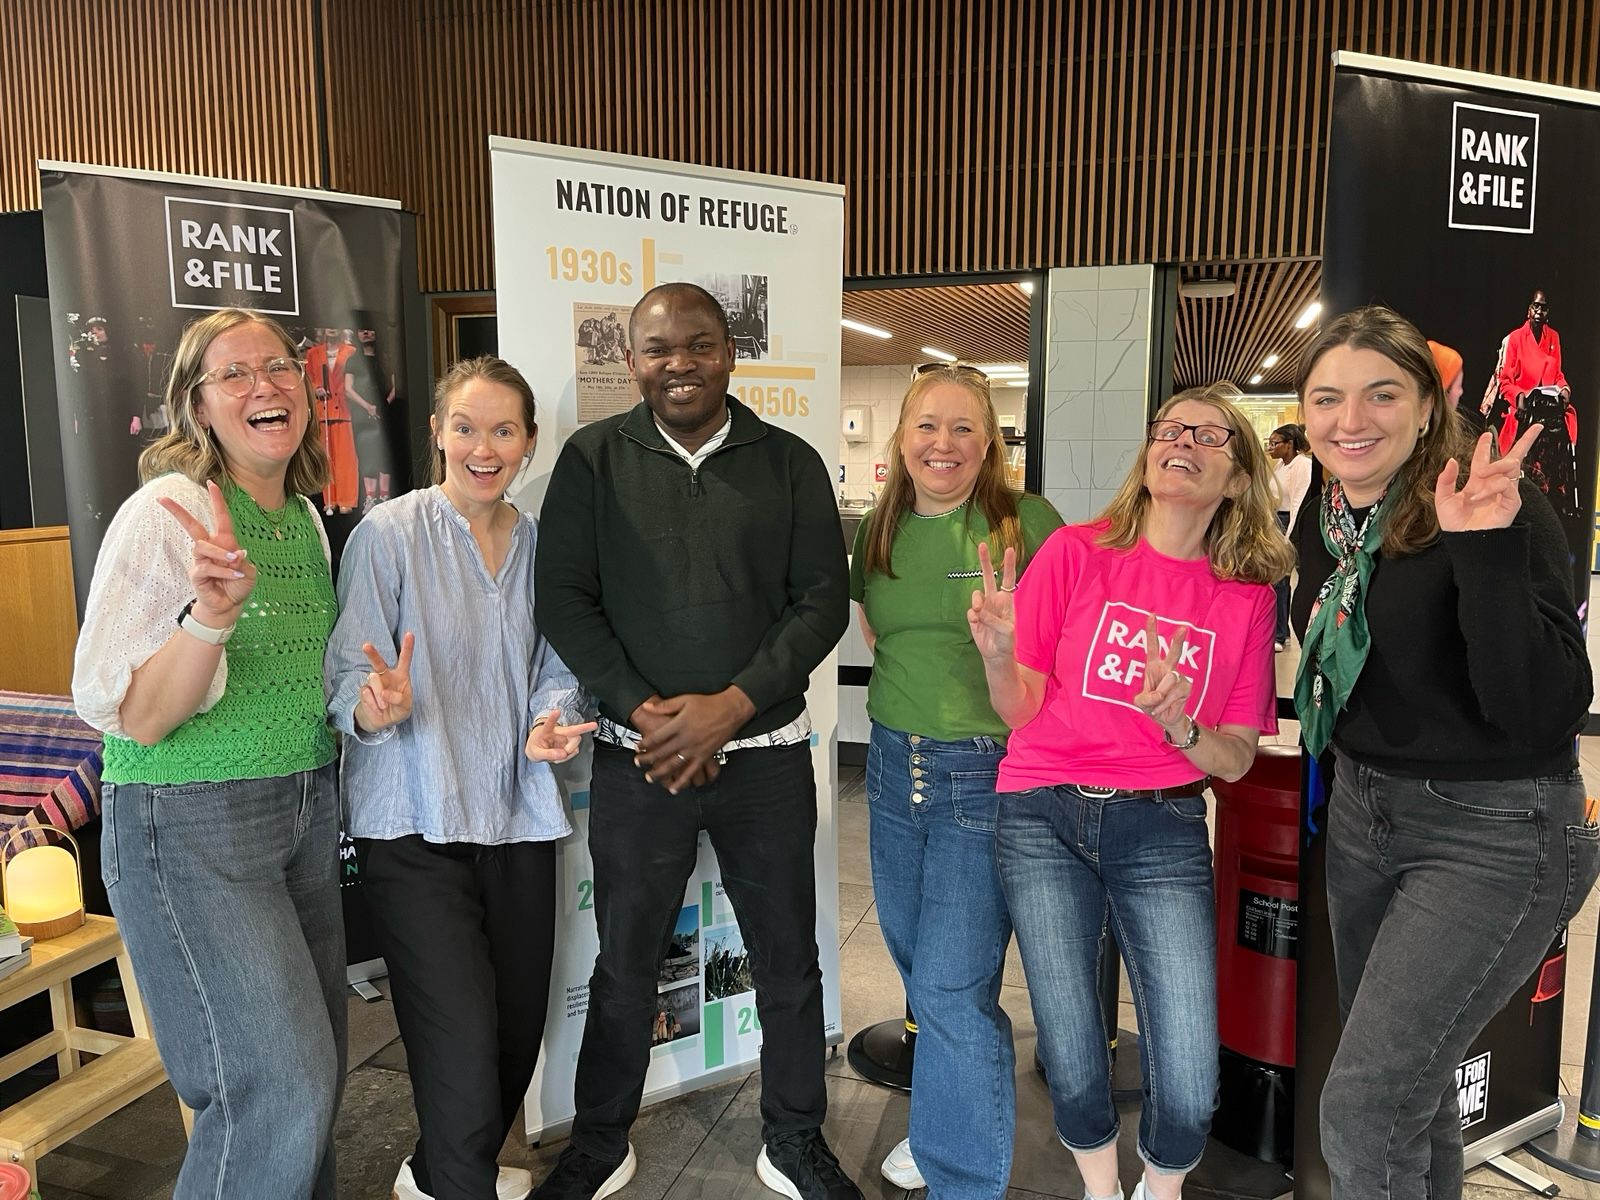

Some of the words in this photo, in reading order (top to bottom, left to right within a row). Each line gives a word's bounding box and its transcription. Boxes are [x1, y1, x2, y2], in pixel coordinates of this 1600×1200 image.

[1461, 128, 1529, 167] RANK
[556, 179, 651, 220] NATION
[660, 192, 690, 224] OF
[699, 197, 789, 235] REFUGE
[1459, 172, 1525, 209] &FILE
[181, 219, 282, 257] RANK
[184, 258, 282, 293] &FILE
[546, 246, 633, 286] 1930s
[736, 385, 810, 418] 1950s
[1253, 896, 1280, 910] School
[1281, 903, 1299, 913] Post
[1464, 1058, 1487, 1087] FOR
[1457, 1079, 1486, 1118] ME
